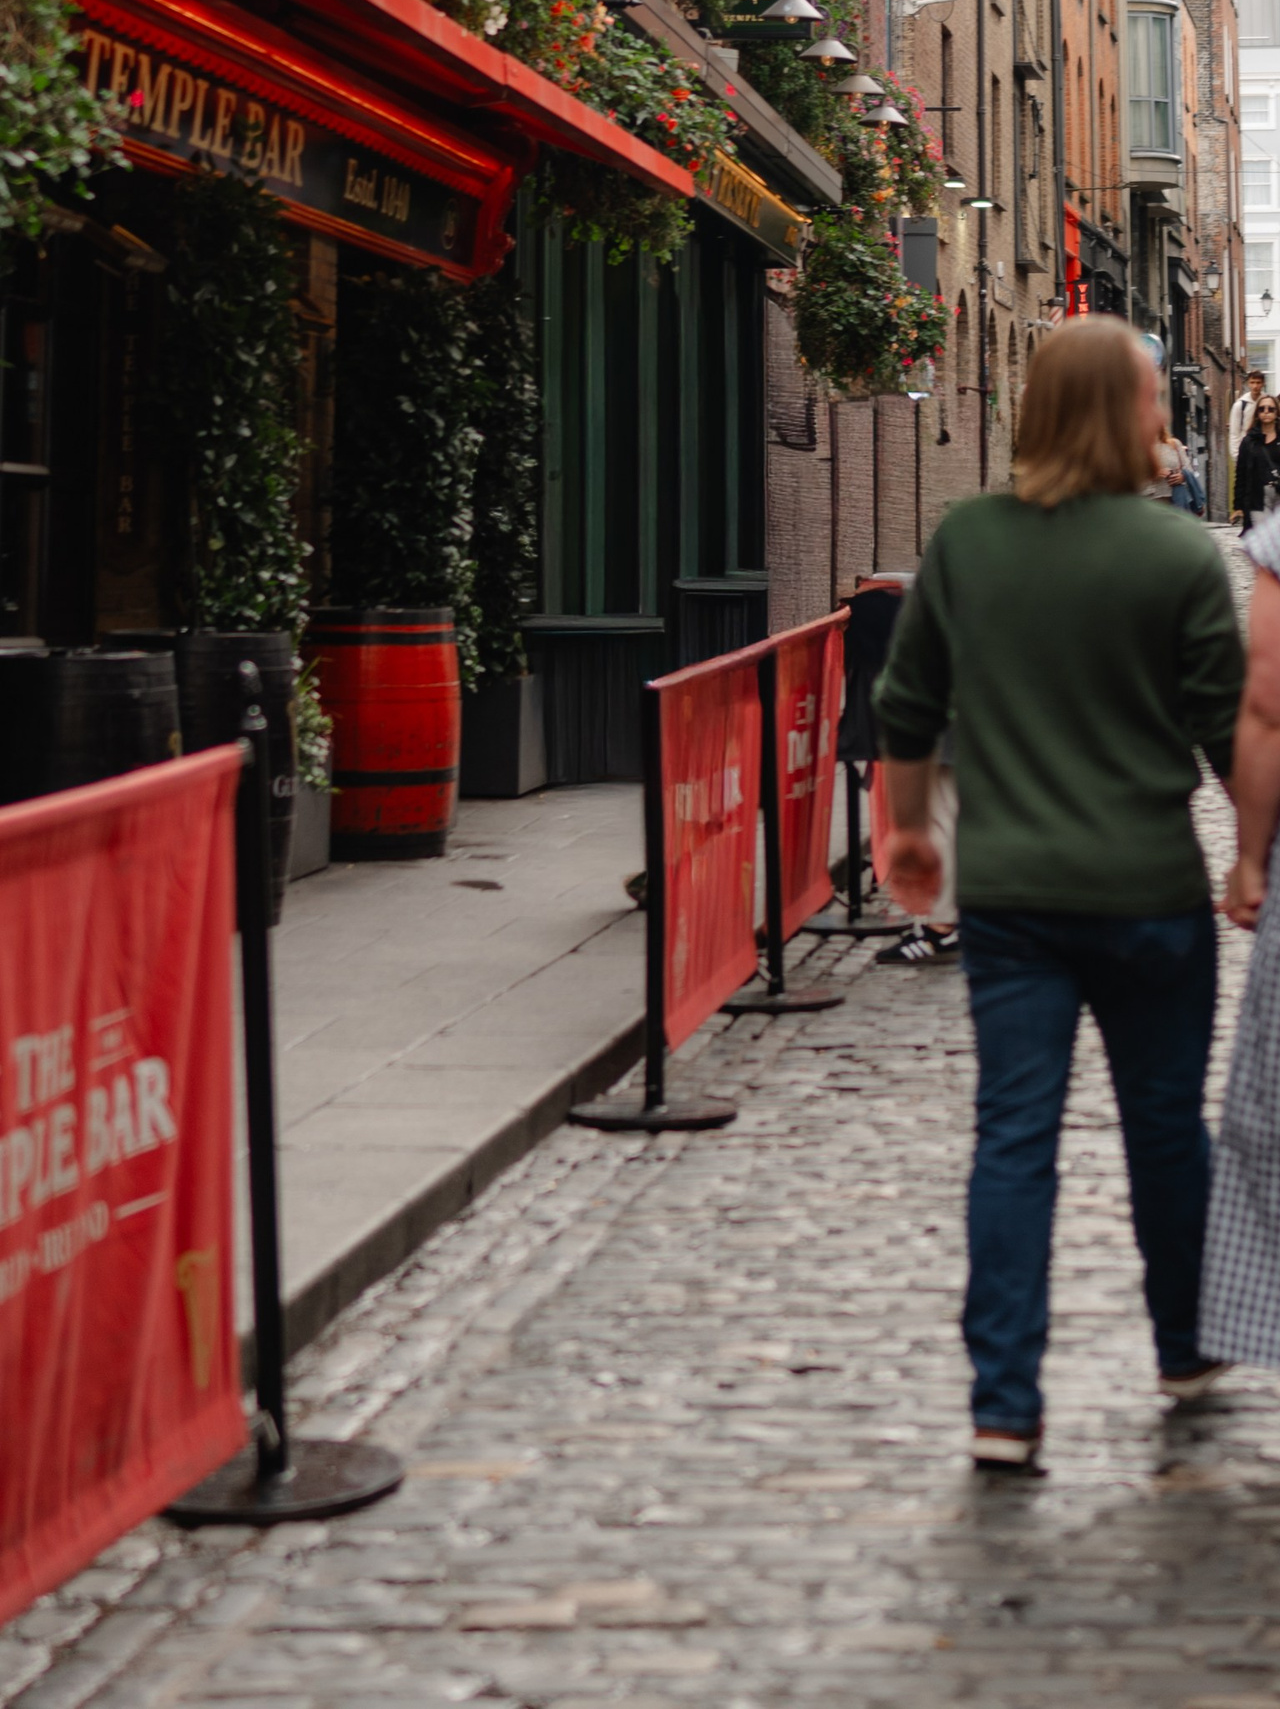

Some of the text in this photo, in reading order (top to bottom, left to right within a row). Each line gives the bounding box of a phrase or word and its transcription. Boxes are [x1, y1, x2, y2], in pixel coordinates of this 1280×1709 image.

[83, 28, 305, 188] TEMPLE BAR
[116, 474, 135, 535] BAR
[13, 1021, 76, 1115] THE
[0, 1055, 178, 1231] PLE BAR
